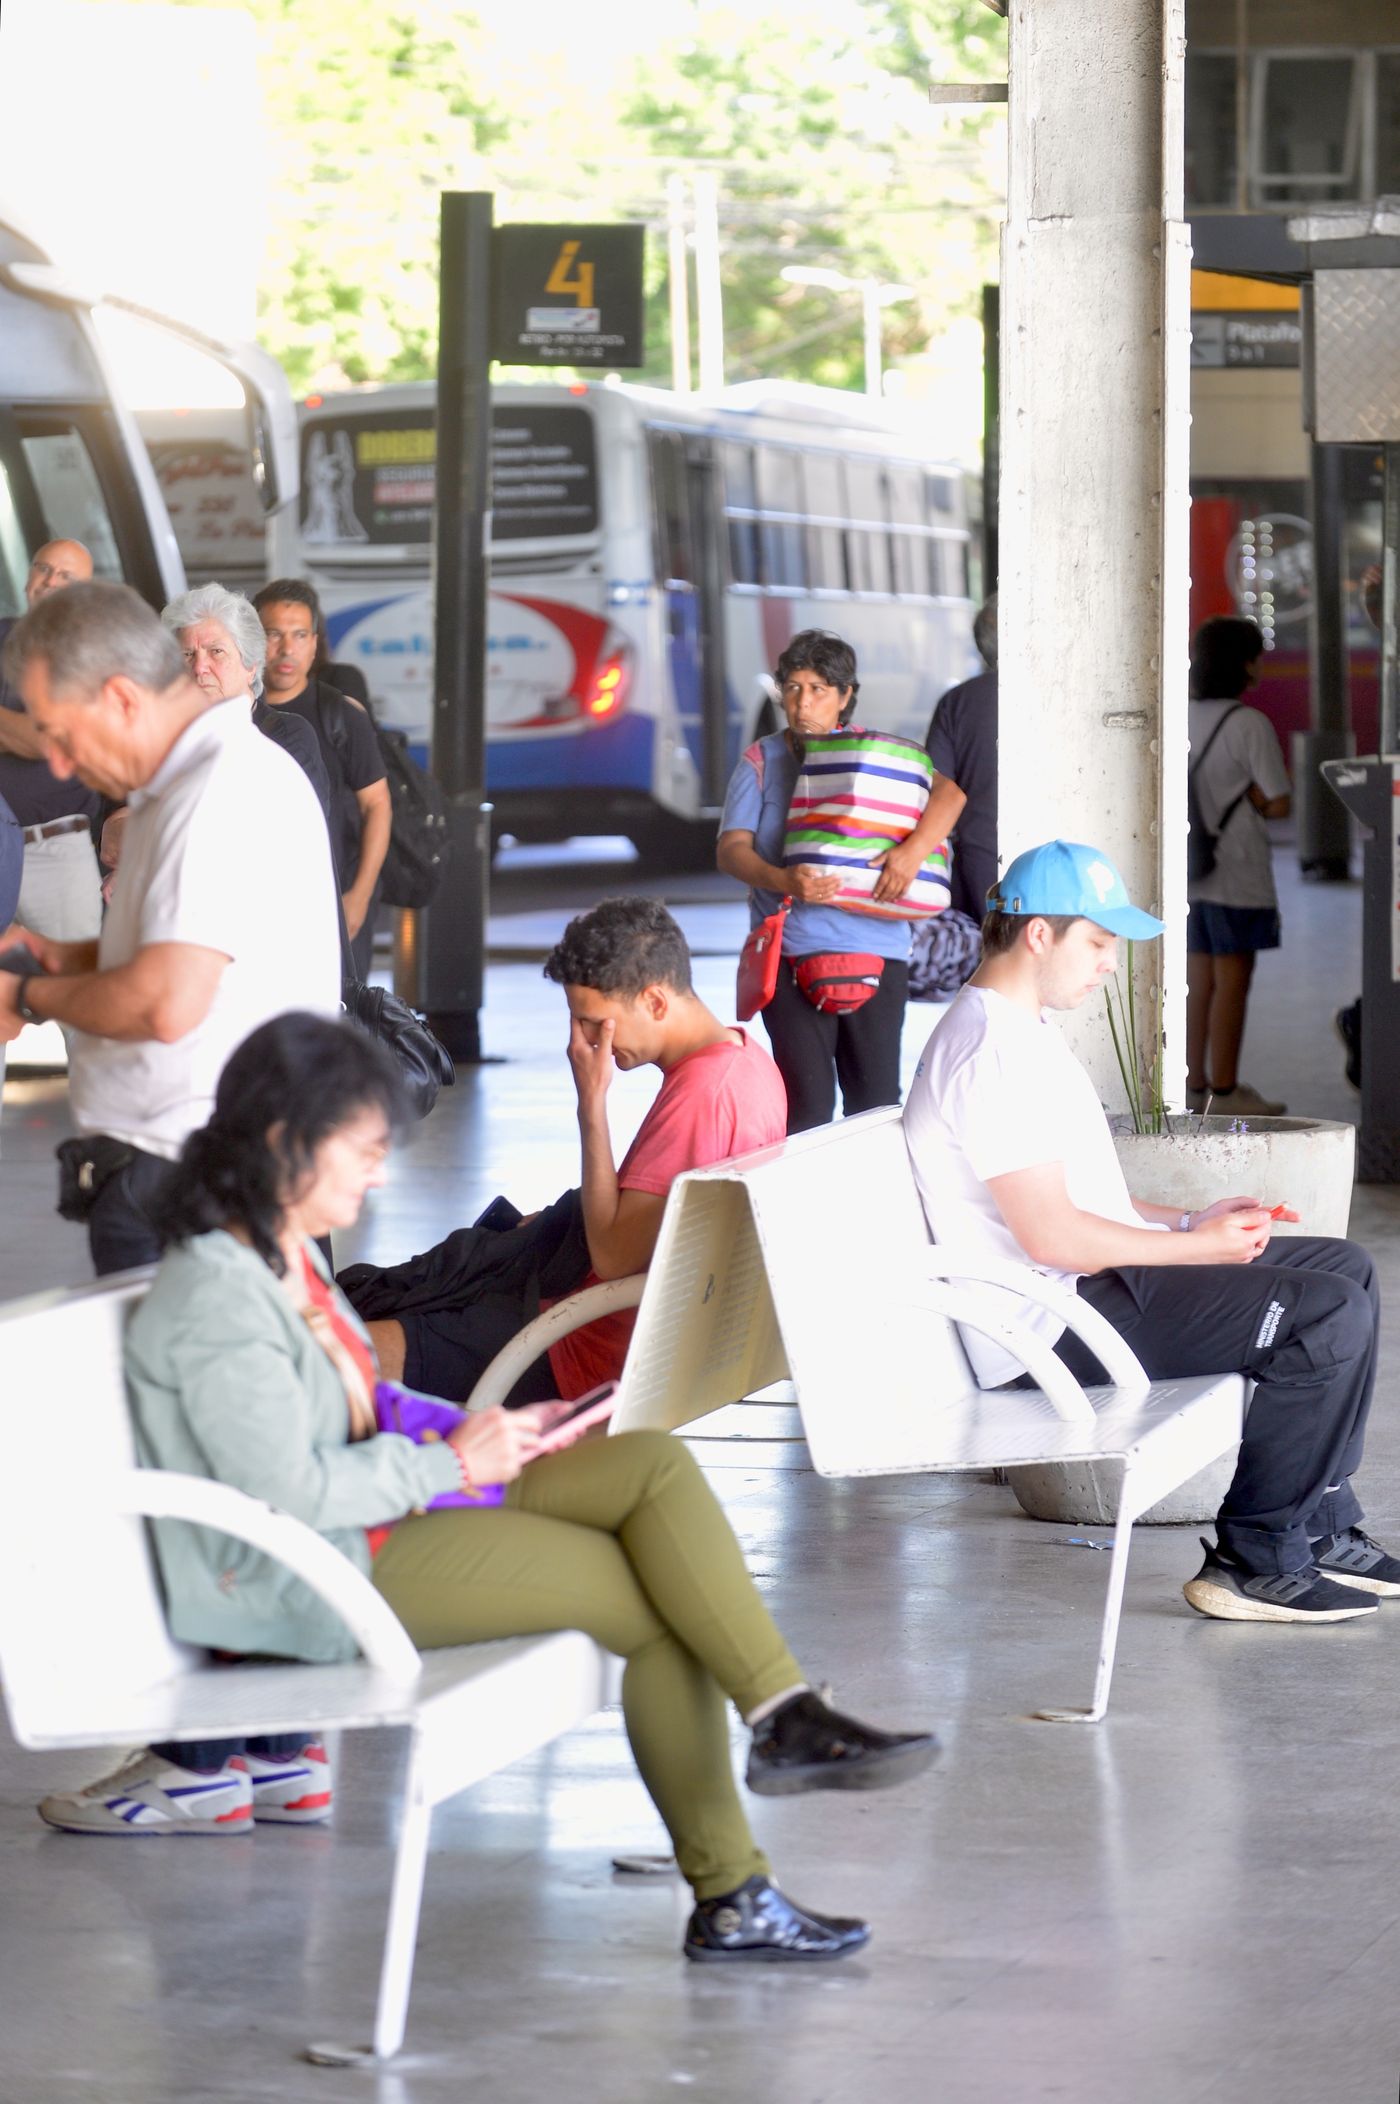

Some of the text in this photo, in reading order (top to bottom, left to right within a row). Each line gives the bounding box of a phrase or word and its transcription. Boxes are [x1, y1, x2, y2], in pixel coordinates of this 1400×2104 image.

[544, 240, 594, 307] 4
[1255, 1301, 1280, 1348] MINISTERIO DE
[1264, 1306, 1285, 1347] TRANSPORTE
